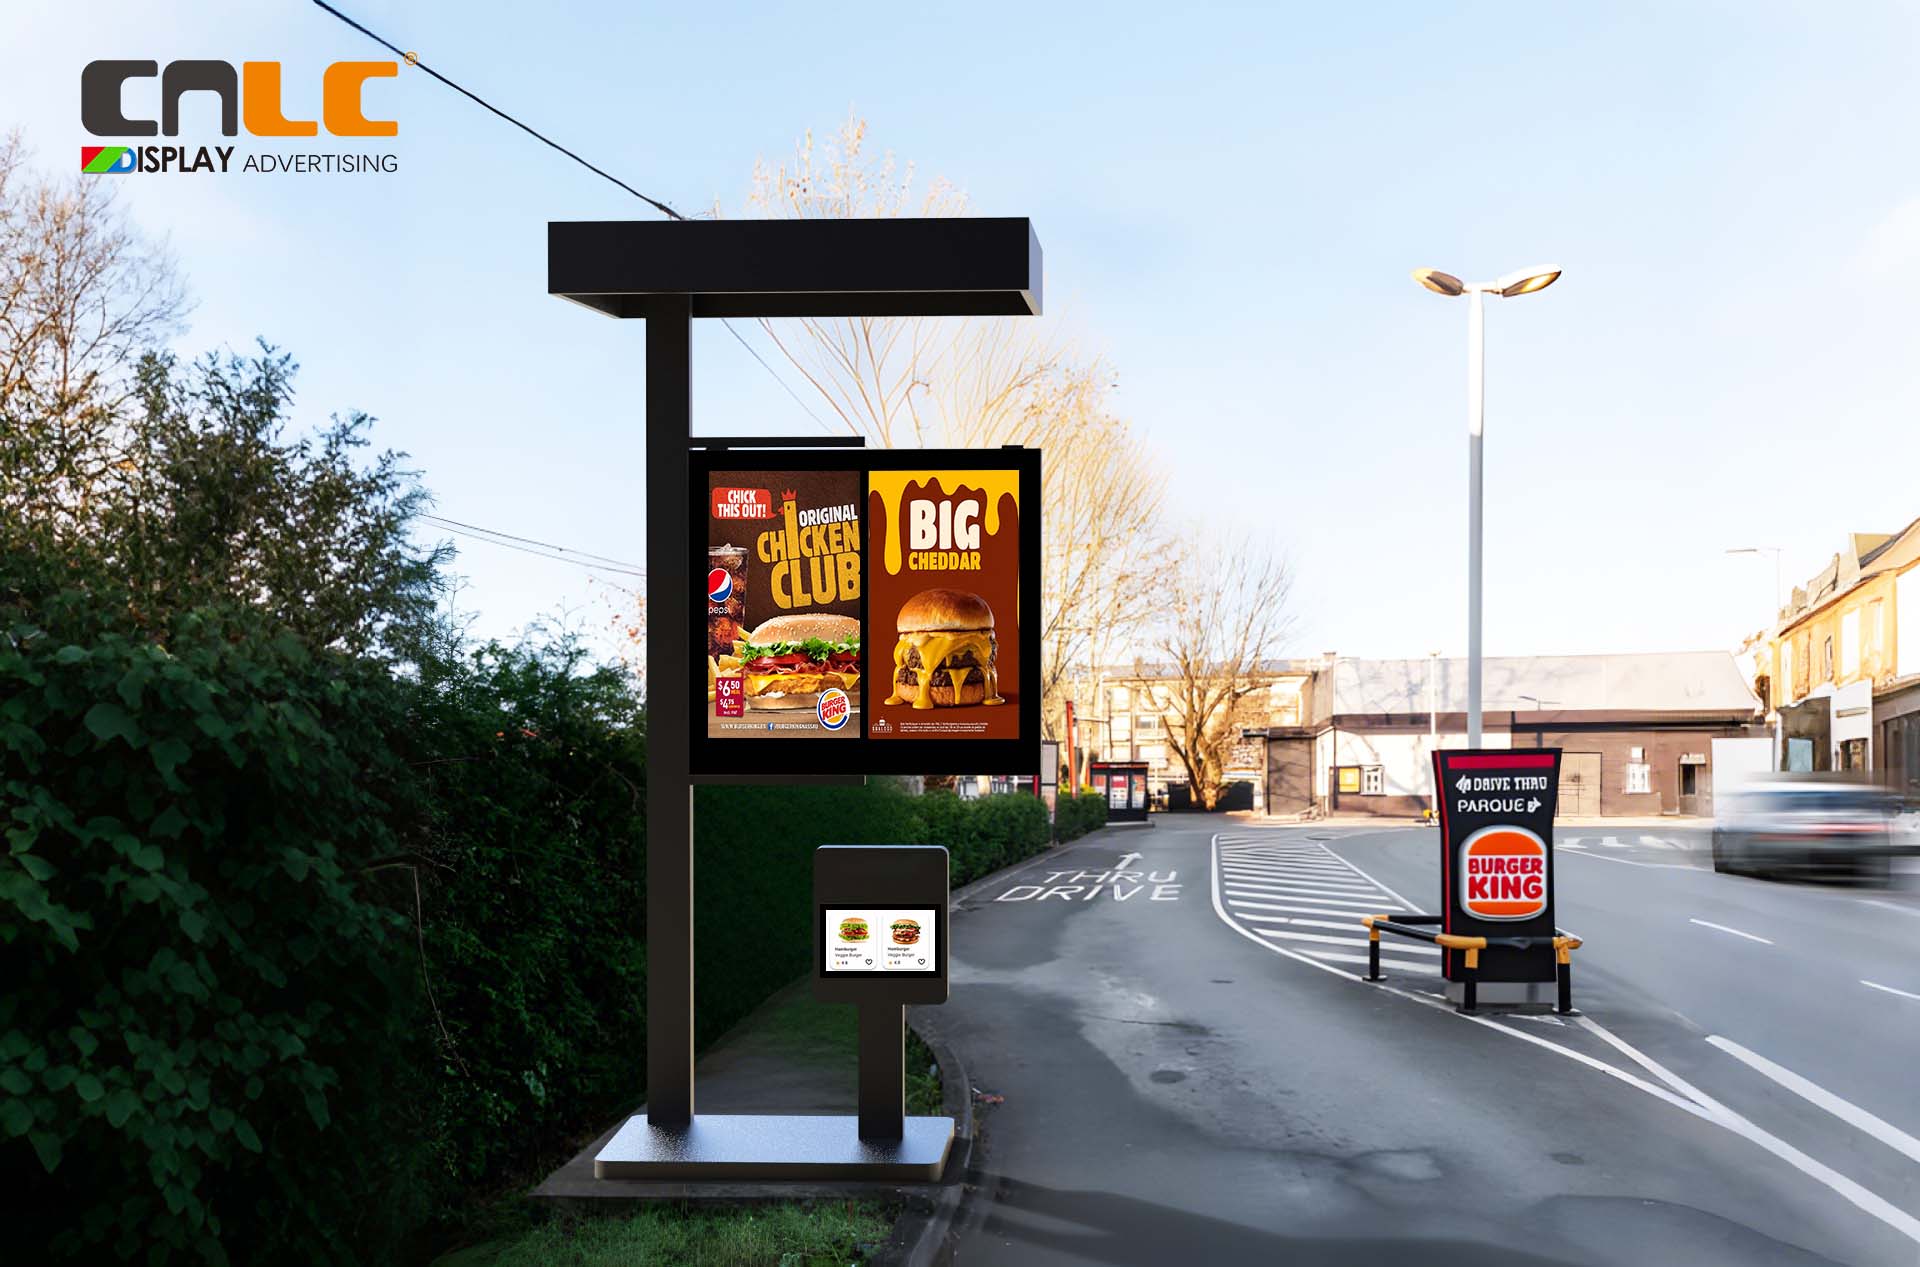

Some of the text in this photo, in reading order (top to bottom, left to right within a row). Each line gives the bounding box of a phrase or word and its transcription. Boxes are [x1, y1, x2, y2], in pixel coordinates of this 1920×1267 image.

[727, 489, 756, 504] CHICK
[717, 503, 767, 518] THIS OUT!
[799, 503, 859, 528] ORIGINAL
[757, 500, 861, 564] CHICKEN
[910, 499, 981, 550] BIG
[908, 551, 982, 571] CHEDDAR
[770, 551, 861, 610] CLUB
[821, 695, 846, 712] BURGER
[821, 703, 847, 721] KING
[1468, 858, 1543, 875] BURGER
[1043, 870, 1178, 883] THRU
[993, 884, 1184, 902] DRIVE
[1468, 875, 1543, 900] KING
